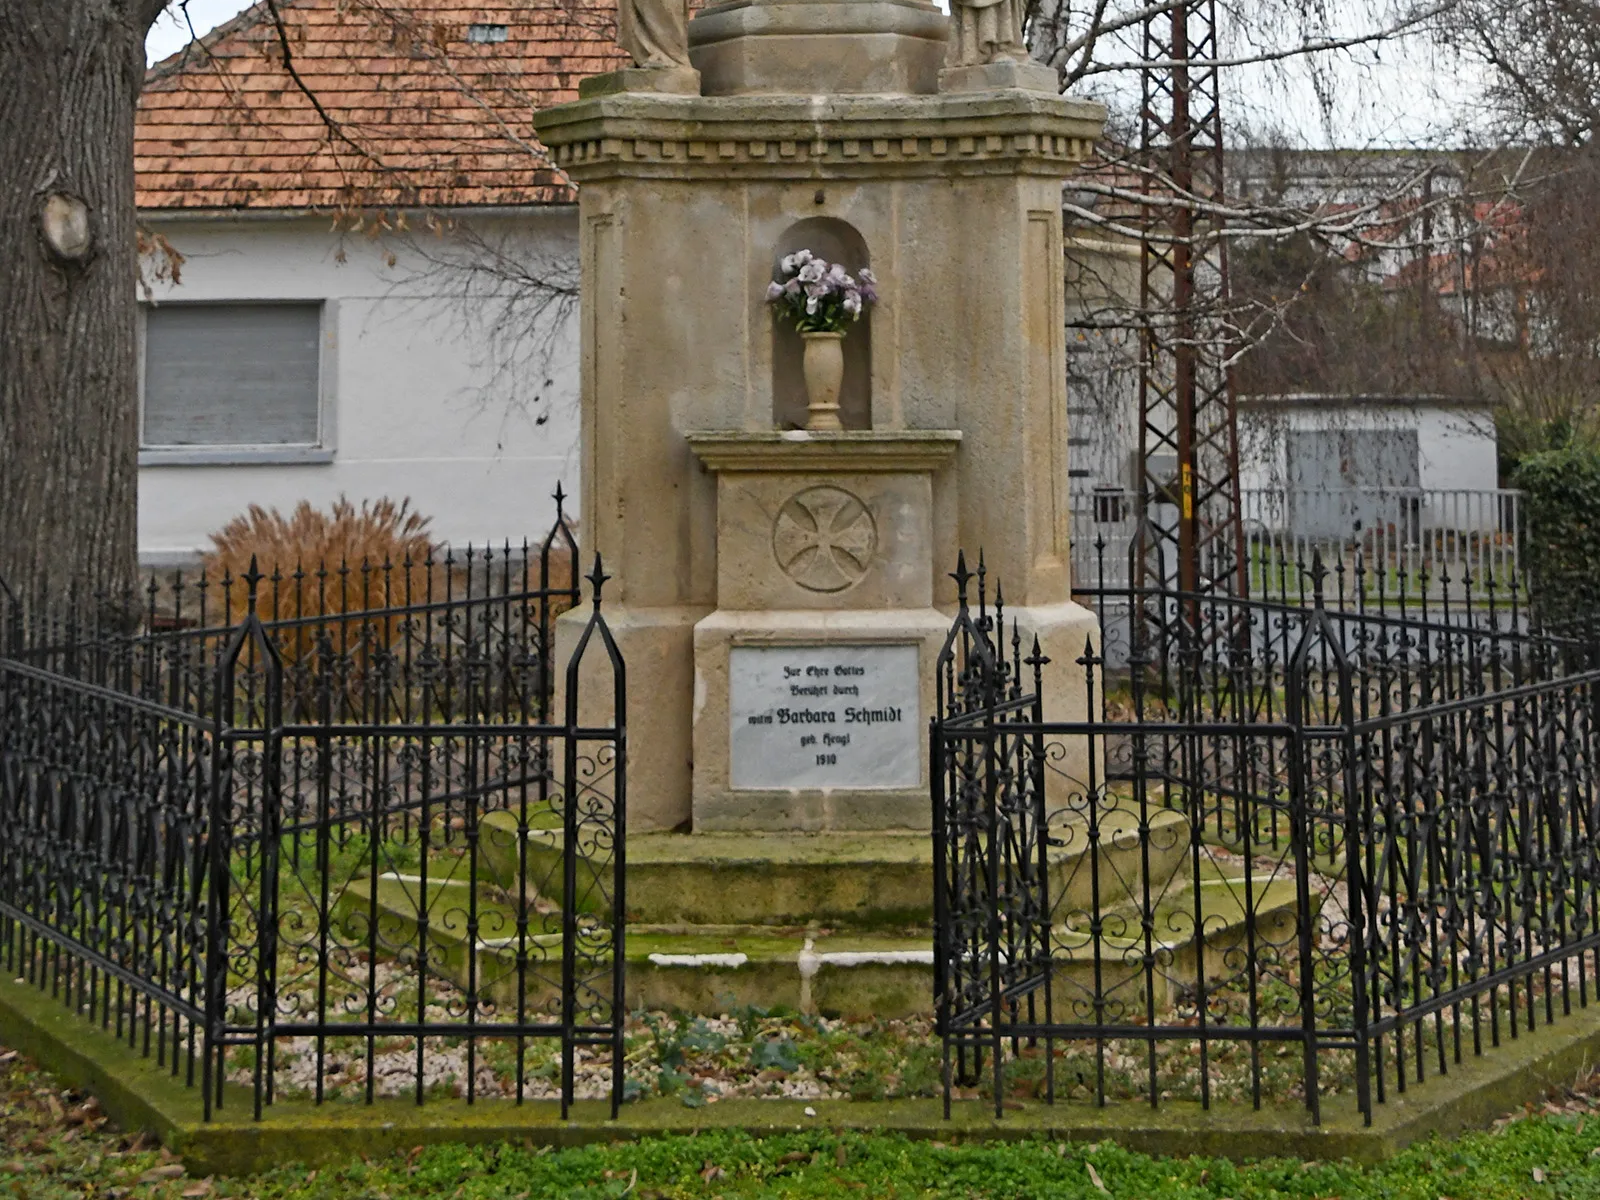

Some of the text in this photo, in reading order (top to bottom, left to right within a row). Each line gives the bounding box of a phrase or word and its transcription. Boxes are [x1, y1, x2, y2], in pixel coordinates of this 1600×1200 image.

[806, 666, 829, 678] Ehre
[777, 708, 836, 724] Barbara
[845, 707, 901, 725] Schmidt
[816, 753, 836, 765] 1910
